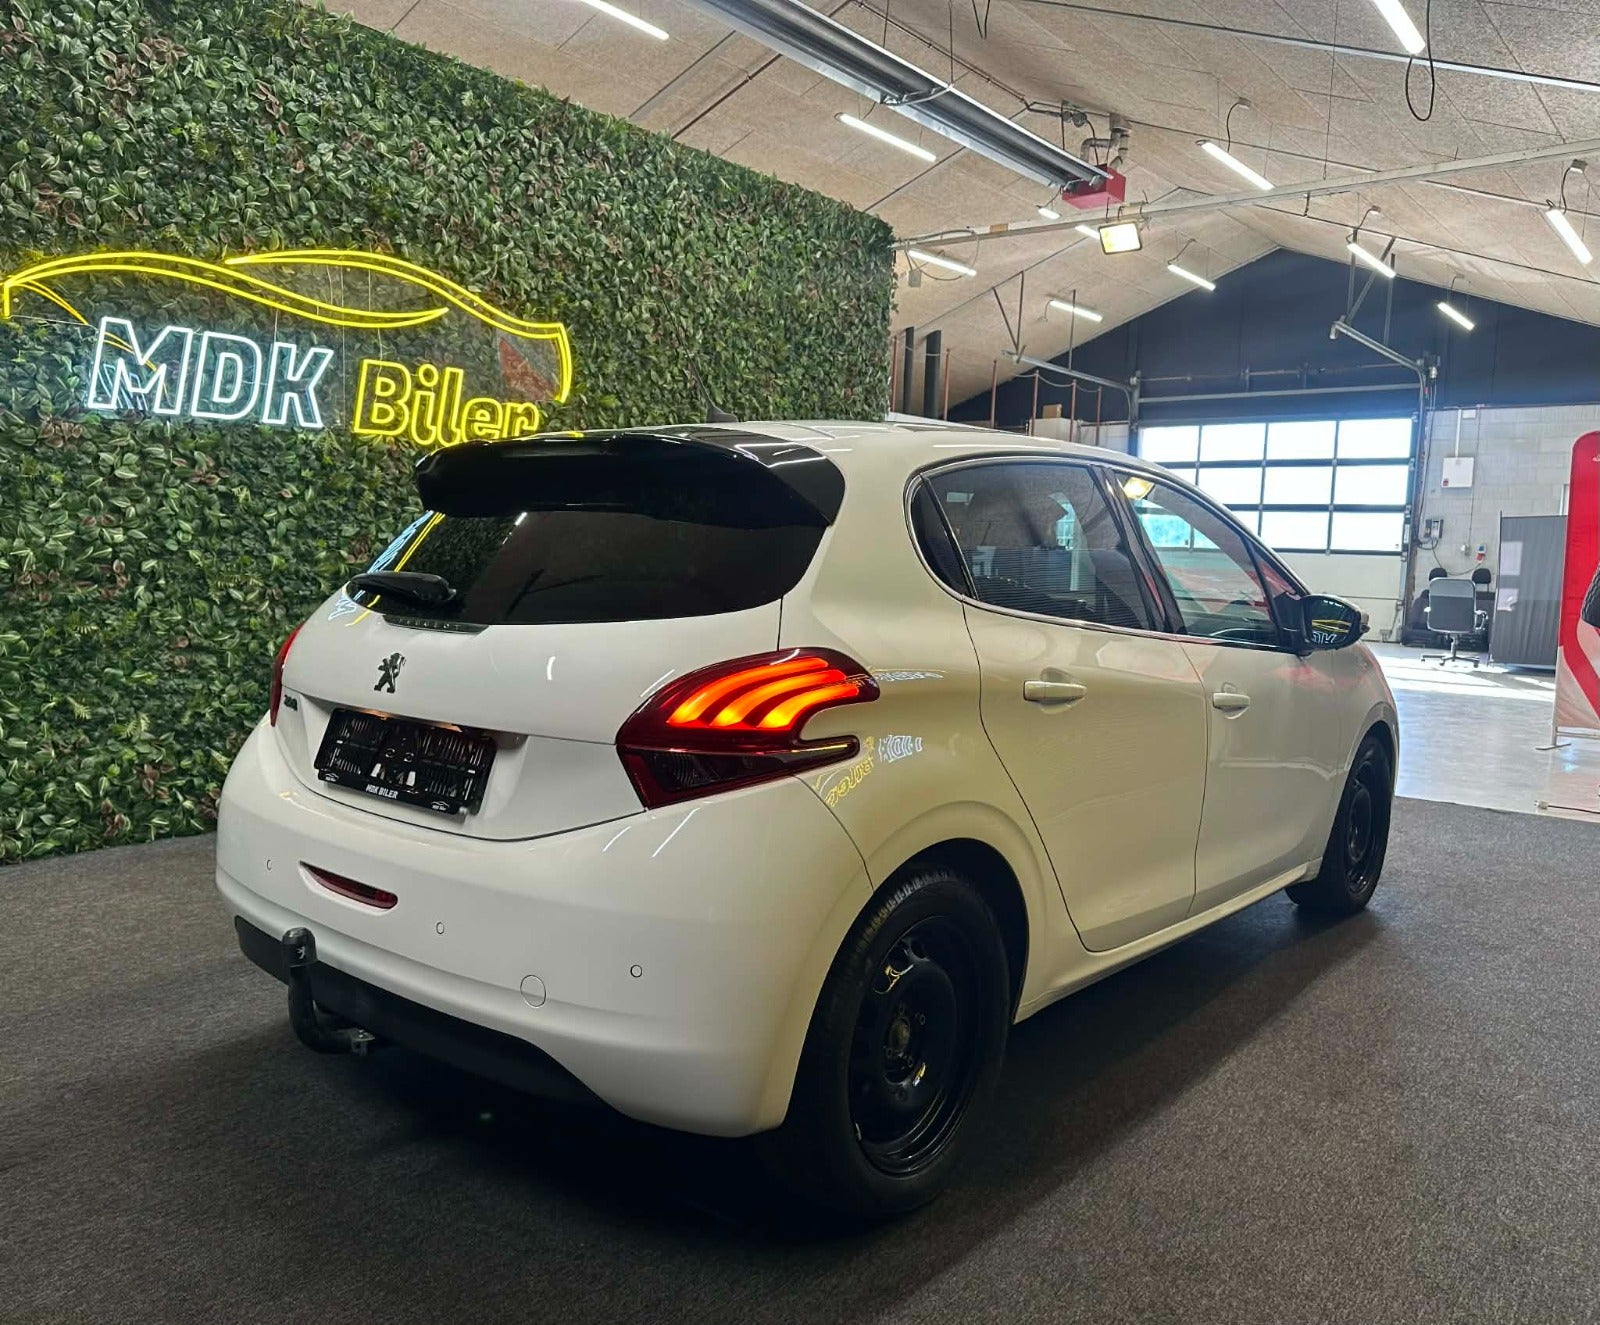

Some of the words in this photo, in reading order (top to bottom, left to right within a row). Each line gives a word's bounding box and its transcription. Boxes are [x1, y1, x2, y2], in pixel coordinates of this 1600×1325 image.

[87, 315, 335, 429] MDK
[353, 358, 540, 447] Biler
[379, 786, 399, 799] BILER
